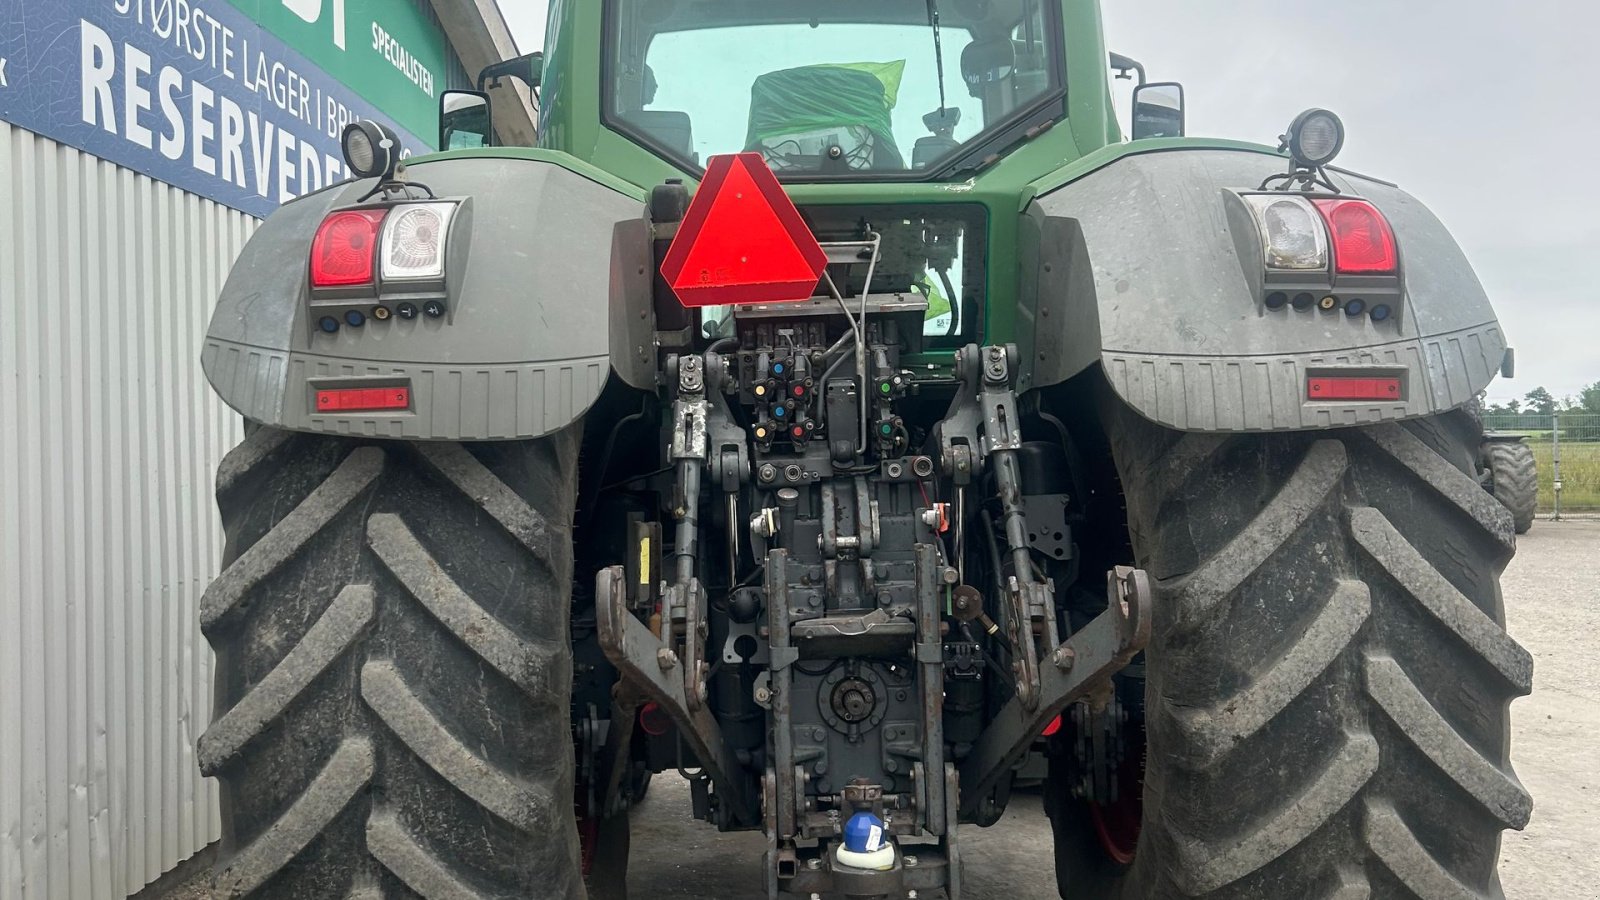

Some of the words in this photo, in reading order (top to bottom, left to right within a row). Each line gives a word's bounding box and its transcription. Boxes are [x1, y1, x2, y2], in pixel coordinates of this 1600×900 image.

[81, 18, 351, 204] RESERVED
[114, 0, 235, 80] ØRSTE
[243, 39, 312, 125] LAGER
[316, 89, 321, 131] I
[372, 21, 434, 99] SPECIALISTEN
